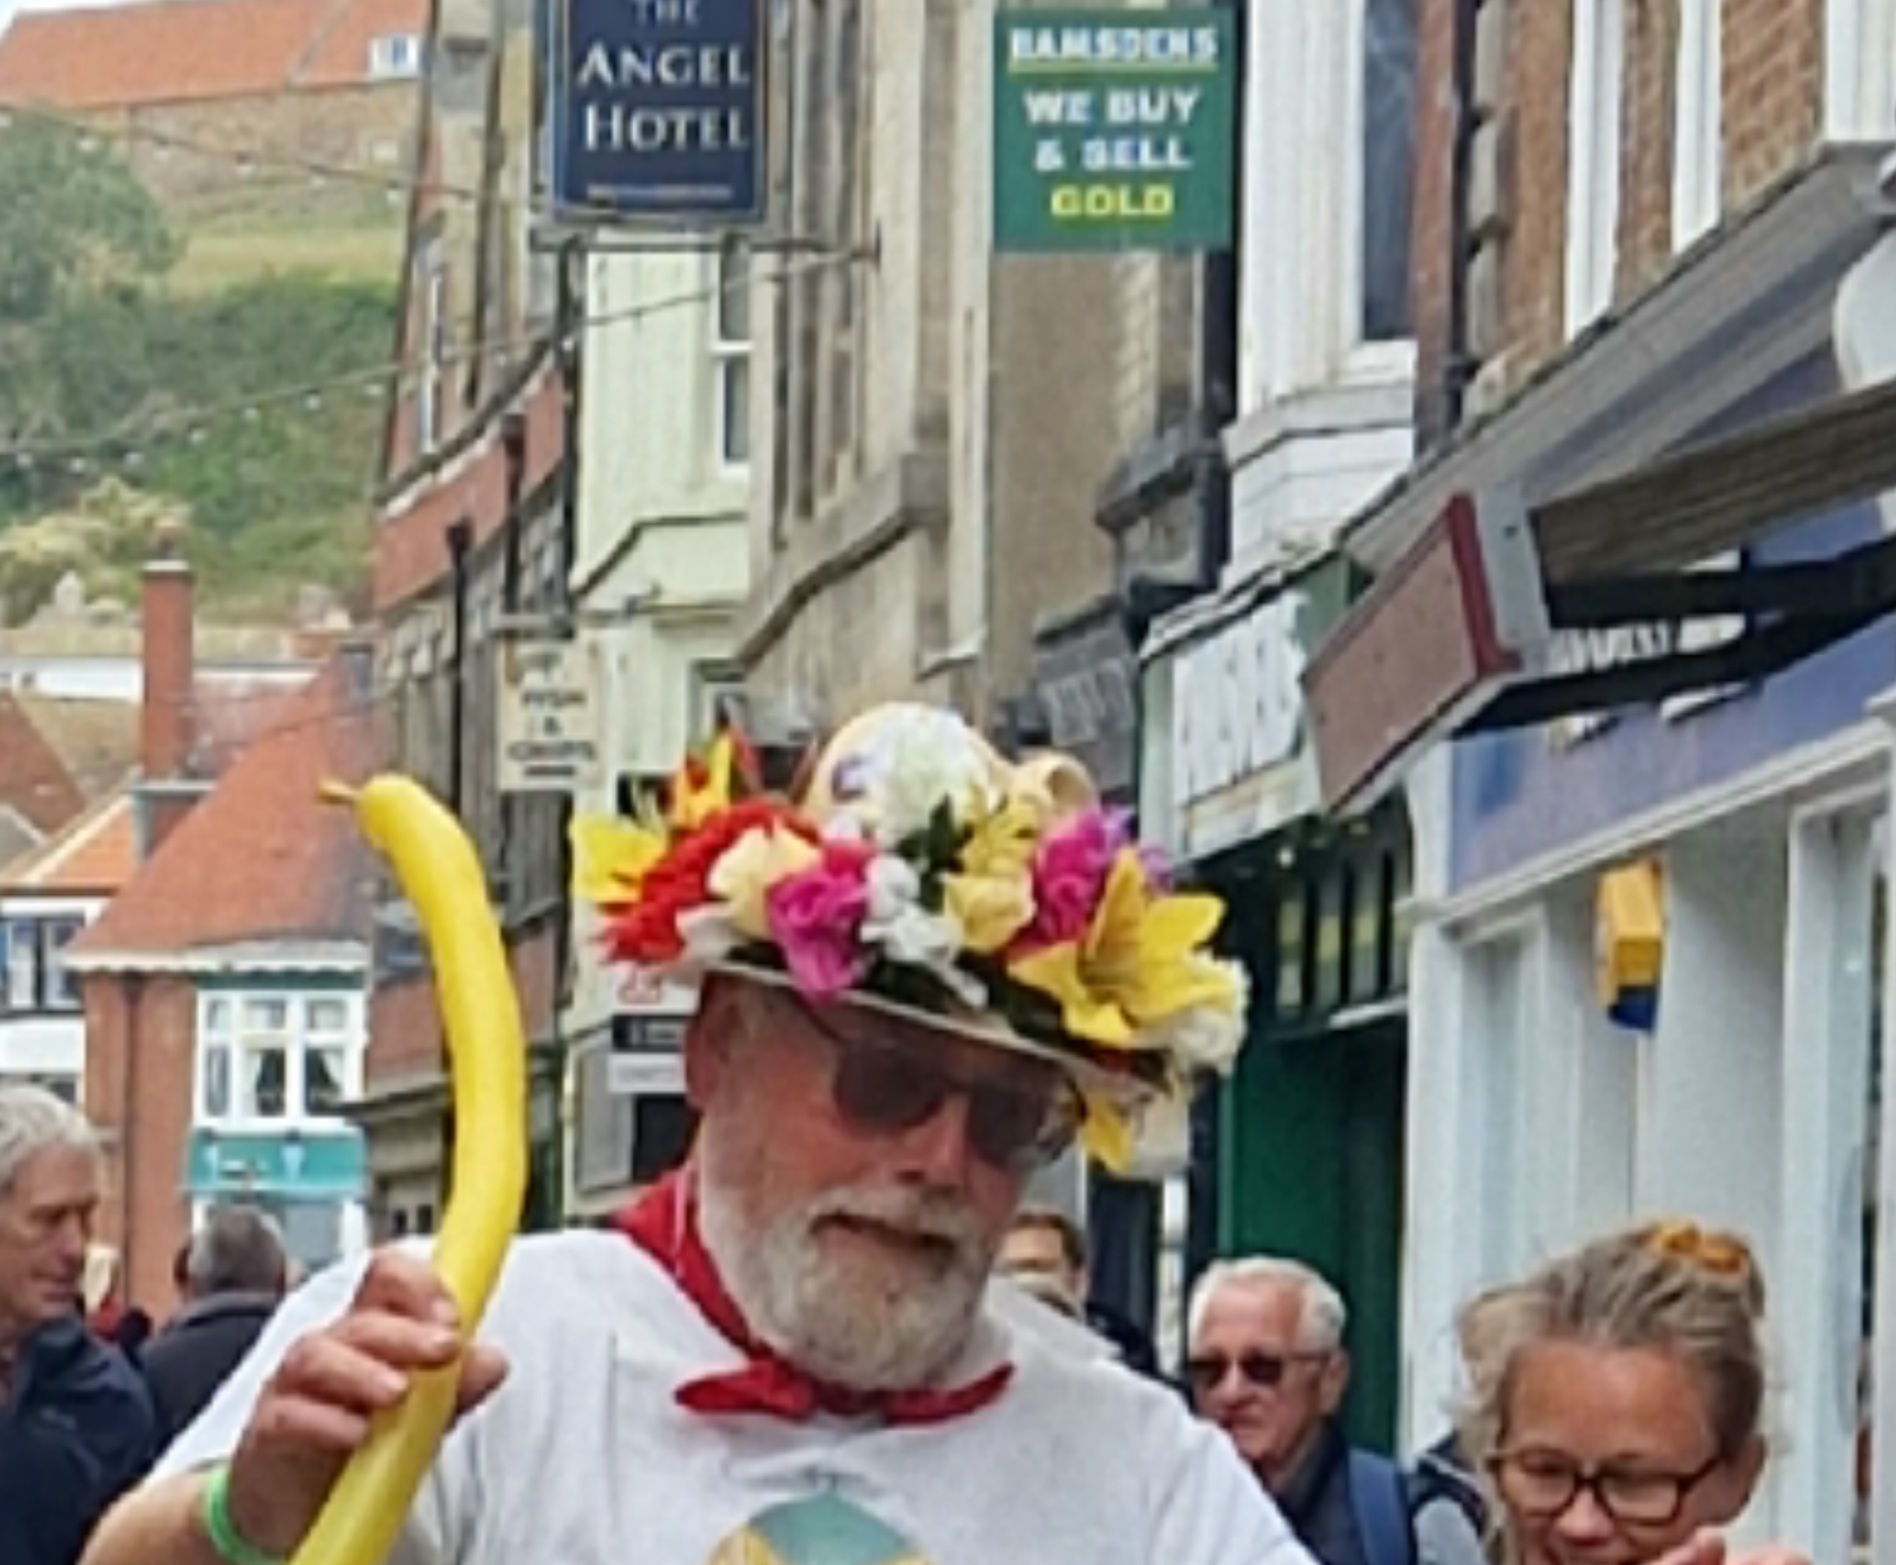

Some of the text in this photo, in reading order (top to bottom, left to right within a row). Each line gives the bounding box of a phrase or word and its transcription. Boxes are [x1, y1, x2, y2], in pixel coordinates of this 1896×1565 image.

[576, 38, 751, 88] ANGEL
[1023, 88, 1200, 124] WE BUY
[583, 103, 751, 152] HOTEL
[1034, 135, 1194, 172] & SELL
[1049, 182, 1176, 217] GOLD
